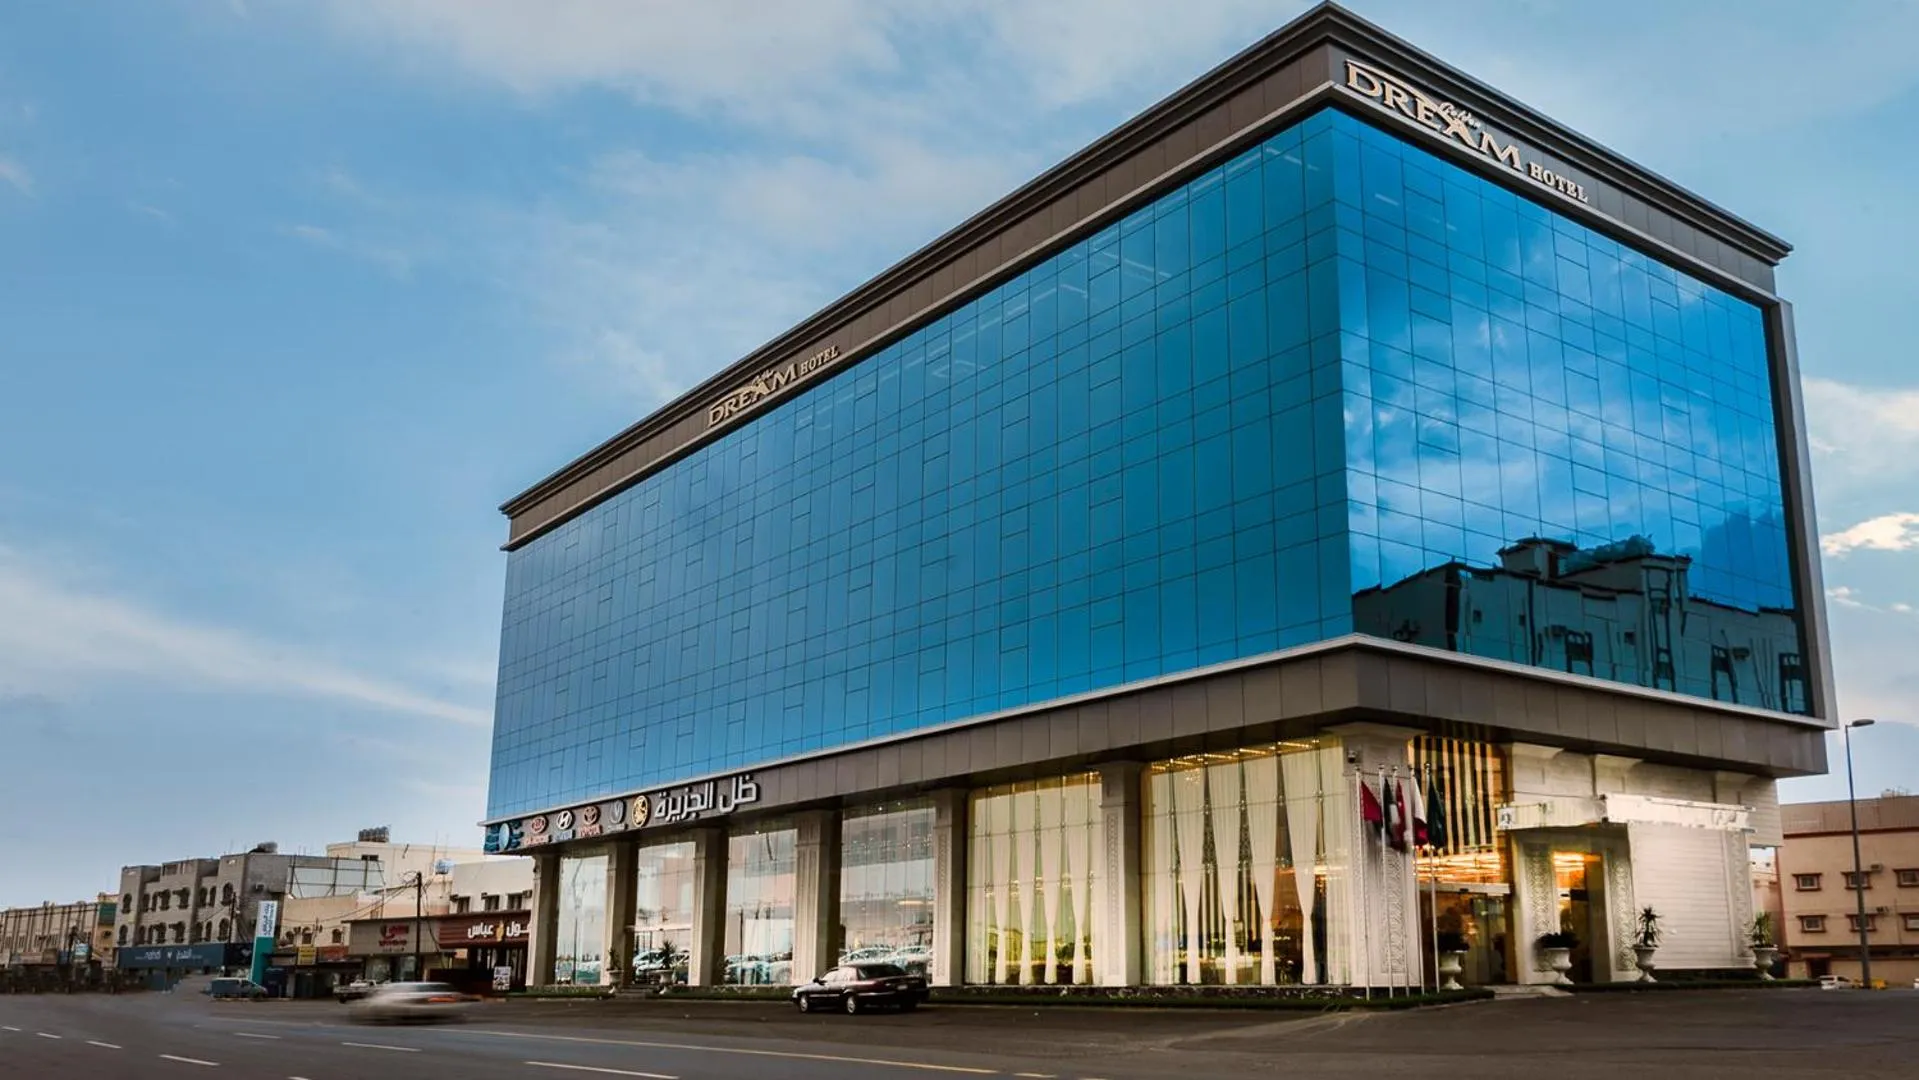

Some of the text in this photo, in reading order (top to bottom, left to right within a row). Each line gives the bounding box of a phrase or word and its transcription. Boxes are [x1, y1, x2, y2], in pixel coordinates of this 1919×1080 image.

[1345, 59, 1589, 204] DREAM HOTEL
[707, 345, 840, 428] DREAM HOTEL
[654, 774, 757, 822] ظل الجزيرة
